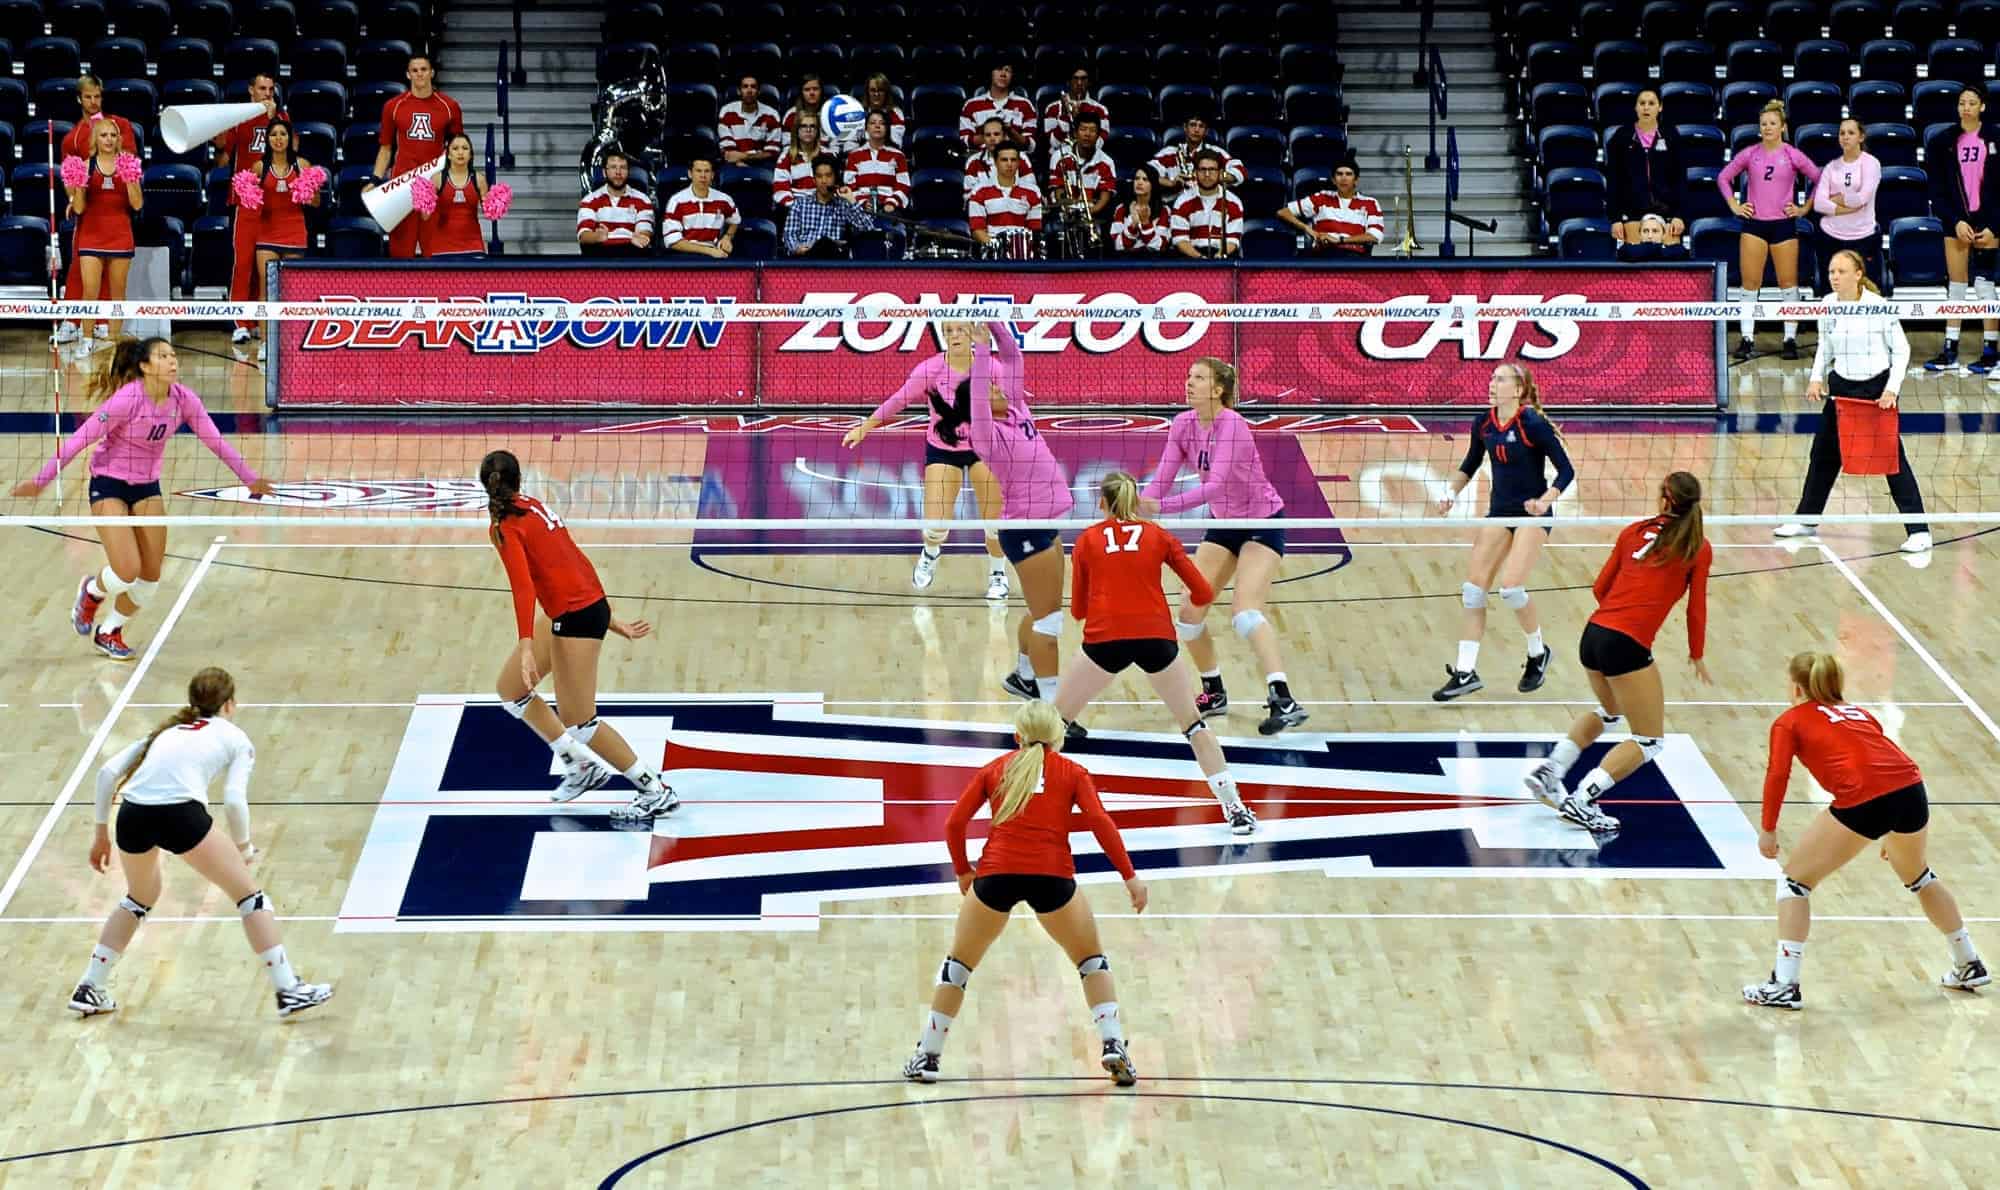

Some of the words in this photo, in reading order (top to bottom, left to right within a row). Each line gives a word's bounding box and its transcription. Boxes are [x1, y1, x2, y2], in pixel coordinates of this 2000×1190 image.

[407, 112, 434, 140] A
[1961, 146, 1980, 162] 33
[1763, 165, 1775, 181] 2
[1844, 172, 1852, 187] 5
[135, 305, 244, 316] ARIZONAWILDCATS
[280, 307, 402, 317] ARIZONAVOLLEYBALL
[437, 307, 545, 317] ARIZONAWILDCATS
[580, 307, 701, 318] ARIZONAVOLLEYBALL
[736, 308, 844, 318] ARIZONAWILDCATS
[878, 308, 999, 318] ARIZONAVOLLEYBALL
[1034, 308, 1142, 318] ARIZONAWILDCATS
[1176, 308, 1298, 318] ARIZONAVOLLEYBALL
[1333, 307, 1441, 318] ARIZONAWILDCATS
[1475, 307, 1597, 317] ARIZONAVOLLEYBALL
[1633, 307, 1742, 317] ARIZONAWILDCATS
[1776, 305, 1900, 316] ARIZONAVOLLEYBALL
[303, 295, 480, 349] BEAR
[533, 296, 737, 348] DOWN
[1021, 291, 1212, 353] ZOO
[1360, 293, 1589, 359] CATS
[146, 423, 168, 441] 10
[1496, 444, 1507, 464] 11
[1102, 524, 1143, 554] 17
[1631, 531, 1660, 560] 7
[1816, 704, 1869, 723] 15
